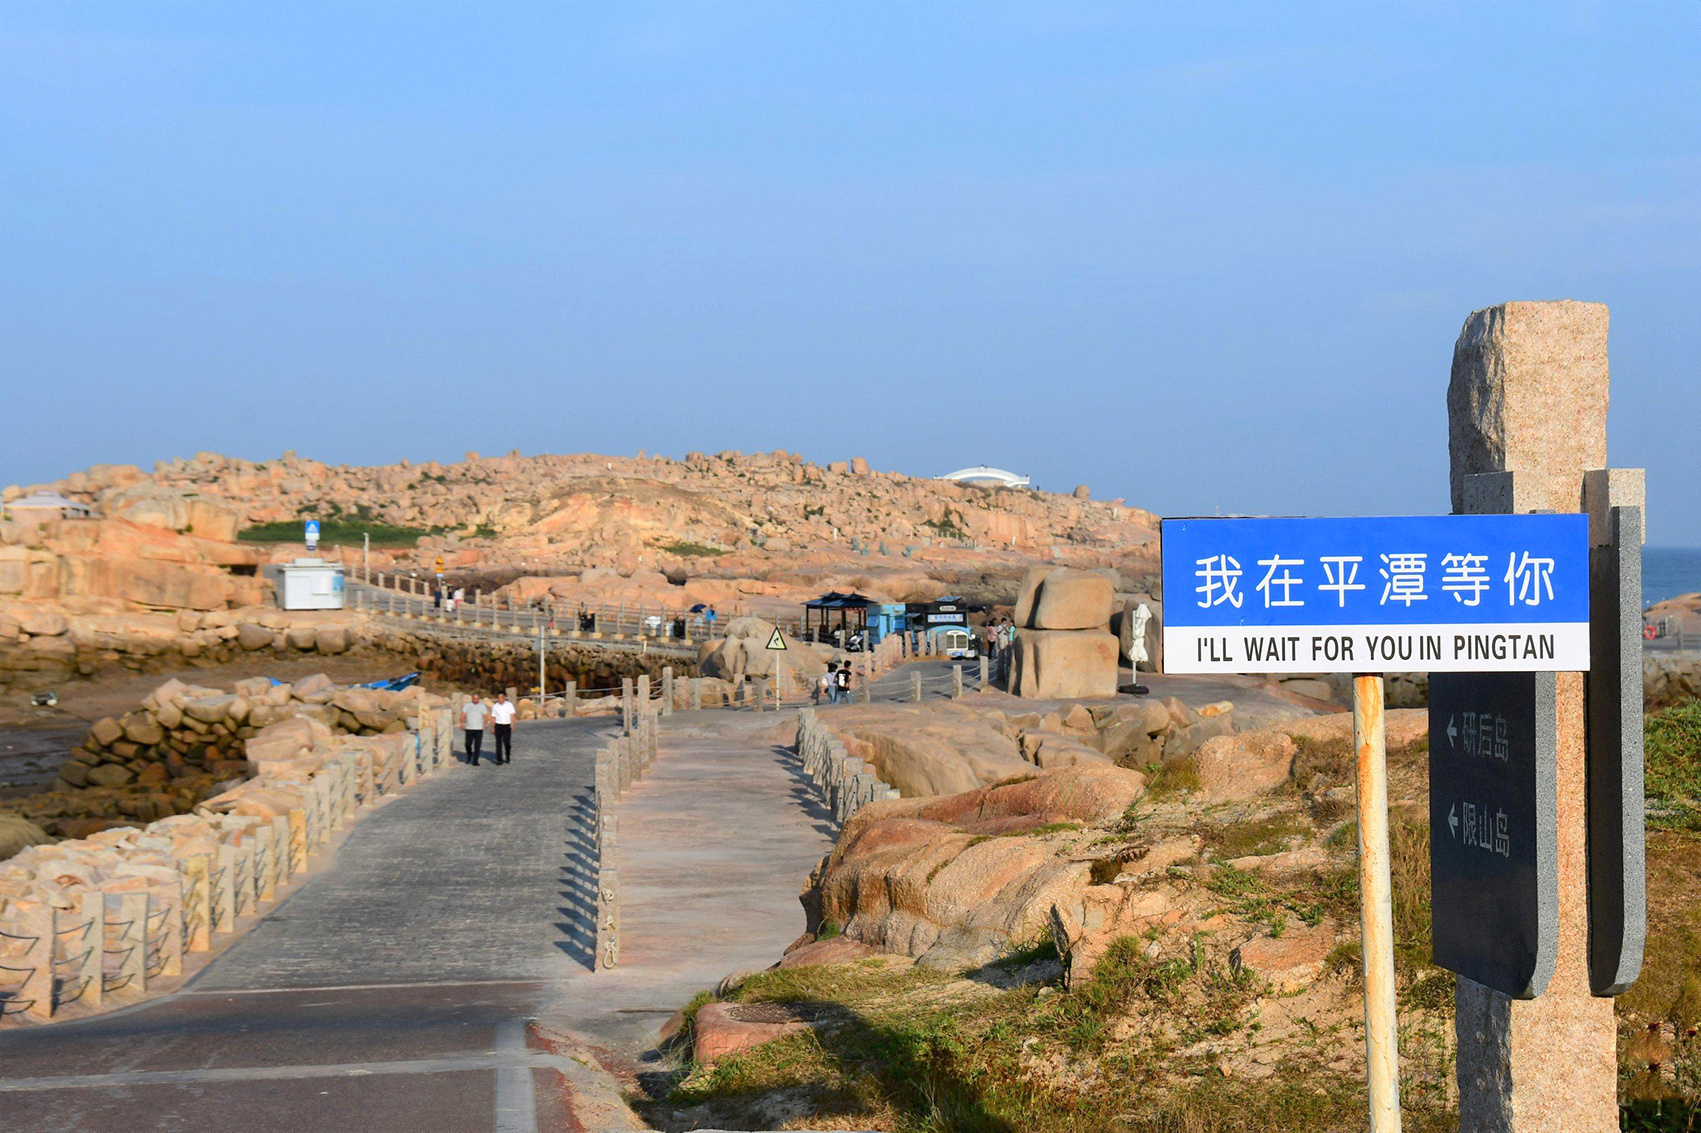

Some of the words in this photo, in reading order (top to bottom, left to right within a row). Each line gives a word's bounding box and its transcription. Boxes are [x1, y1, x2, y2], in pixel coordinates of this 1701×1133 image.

[1195, 551, 1554, 608] 我在平潭等你
[1198, 638, 1232, 661] I'LL
[1244, 637, 1299, 661] WAIT
[1313, 636, 1353, 661] FOR
[1366, 636, 1412, 660] YOU
[1420, 636, 1441, 660] IN
[1455, 635, 1554, 659] PINGTAN
